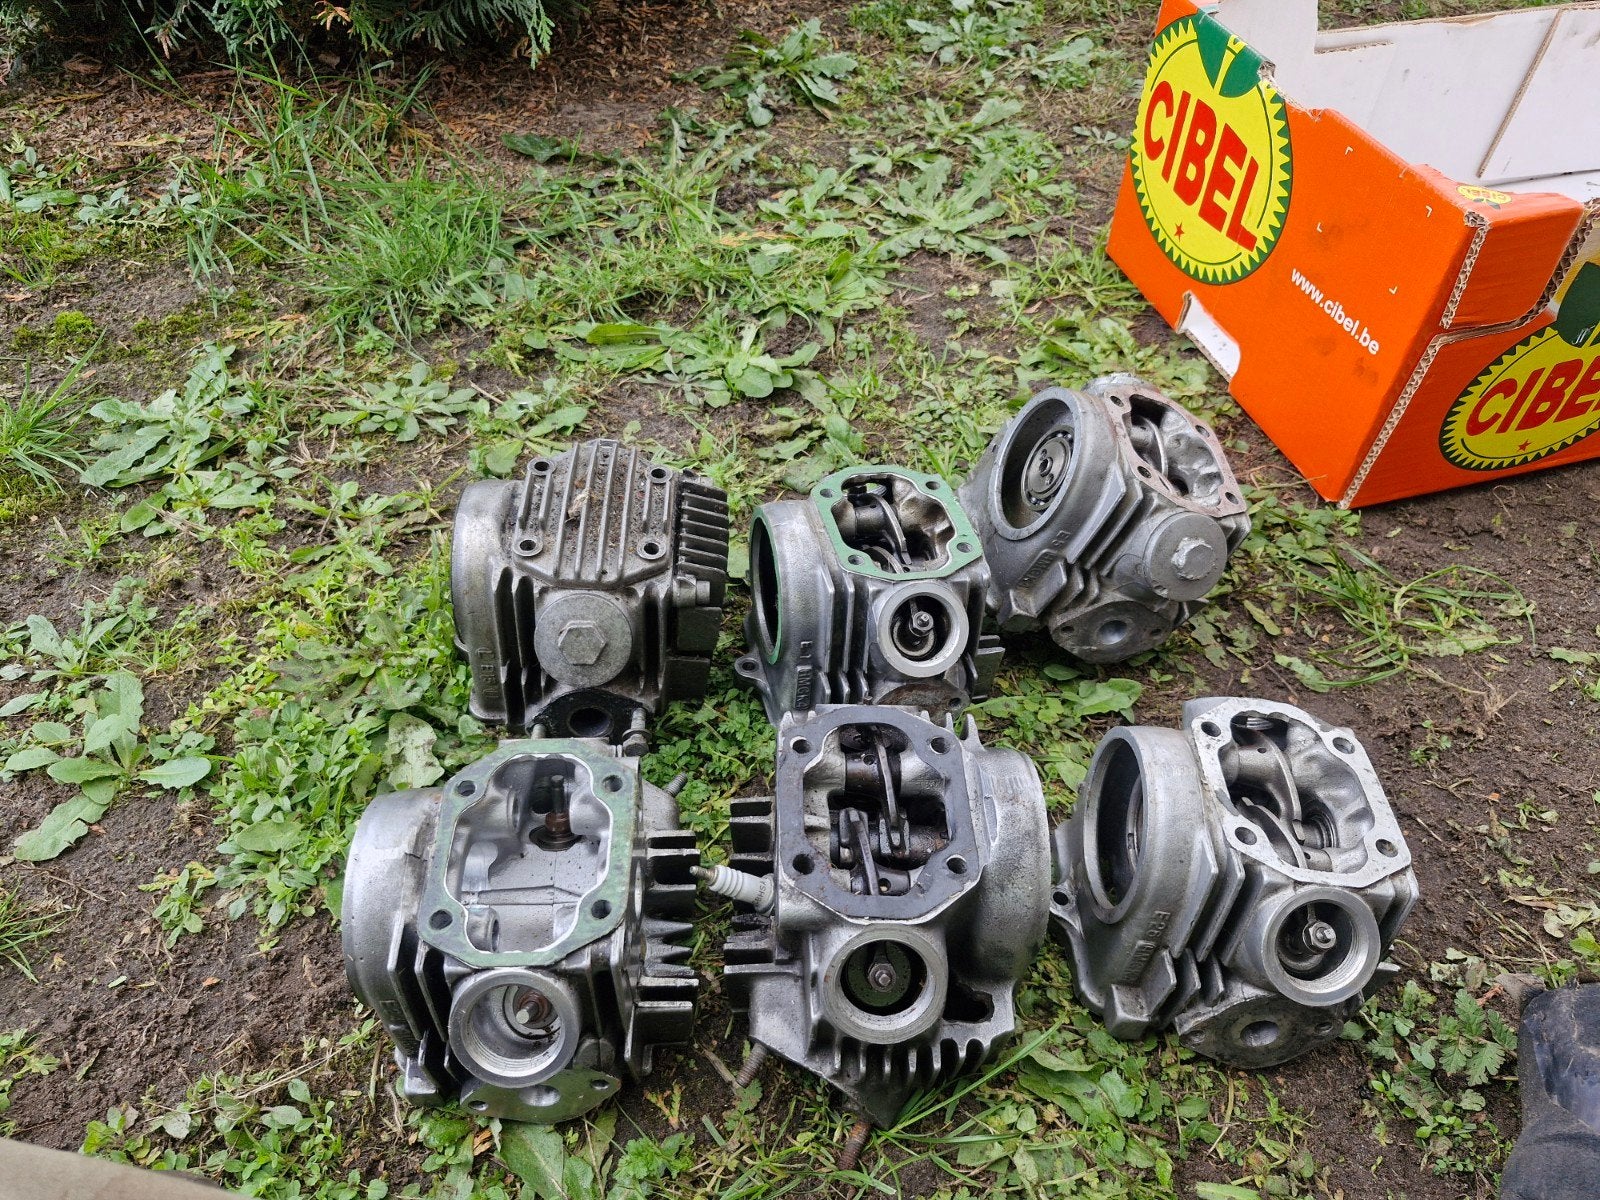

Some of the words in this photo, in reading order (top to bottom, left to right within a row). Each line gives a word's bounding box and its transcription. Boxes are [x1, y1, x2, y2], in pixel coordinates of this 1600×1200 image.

[1144, 80, 1259, 253] CIBEL
[1291, 268, 1380, 355] www.cibel.be
[1466, 354, 1600, 436] CIBE
